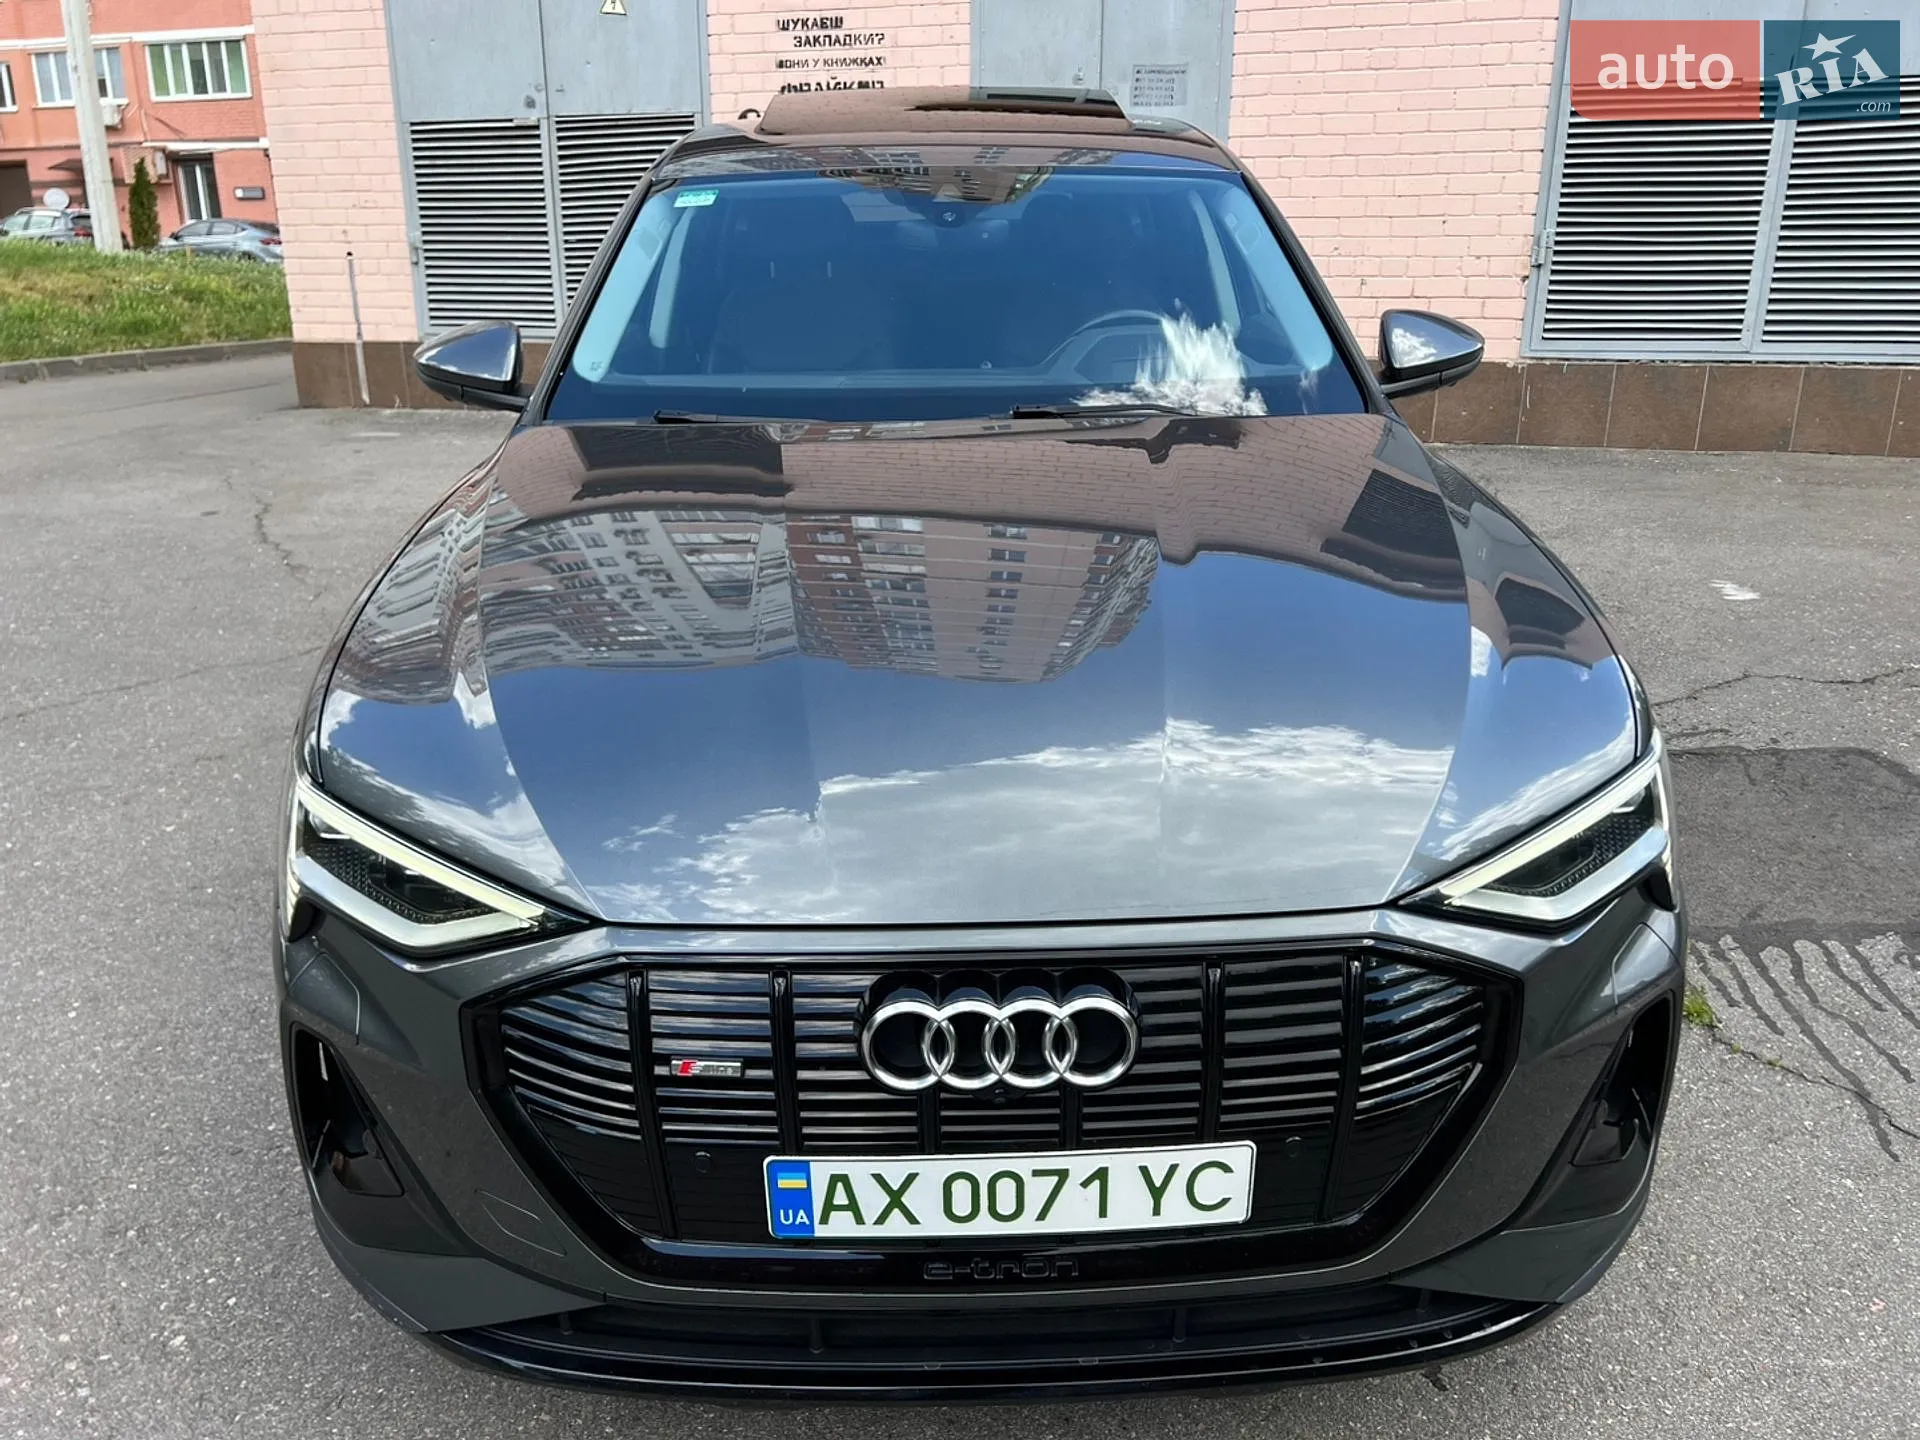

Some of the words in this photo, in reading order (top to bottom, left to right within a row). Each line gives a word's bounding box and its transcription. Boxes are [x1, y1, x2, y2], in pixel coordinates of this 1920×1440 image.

[793, 33, 885, 48] ЗАКЛАДКИ?
[812, 58, 820, 68] У
[818, 1172, 921, 1226] AX
[942, 1165, 1110, 1224] 0071
[1138, 1160, 1235, 1217] YC
[780, 1209, 810, 1225] UA
